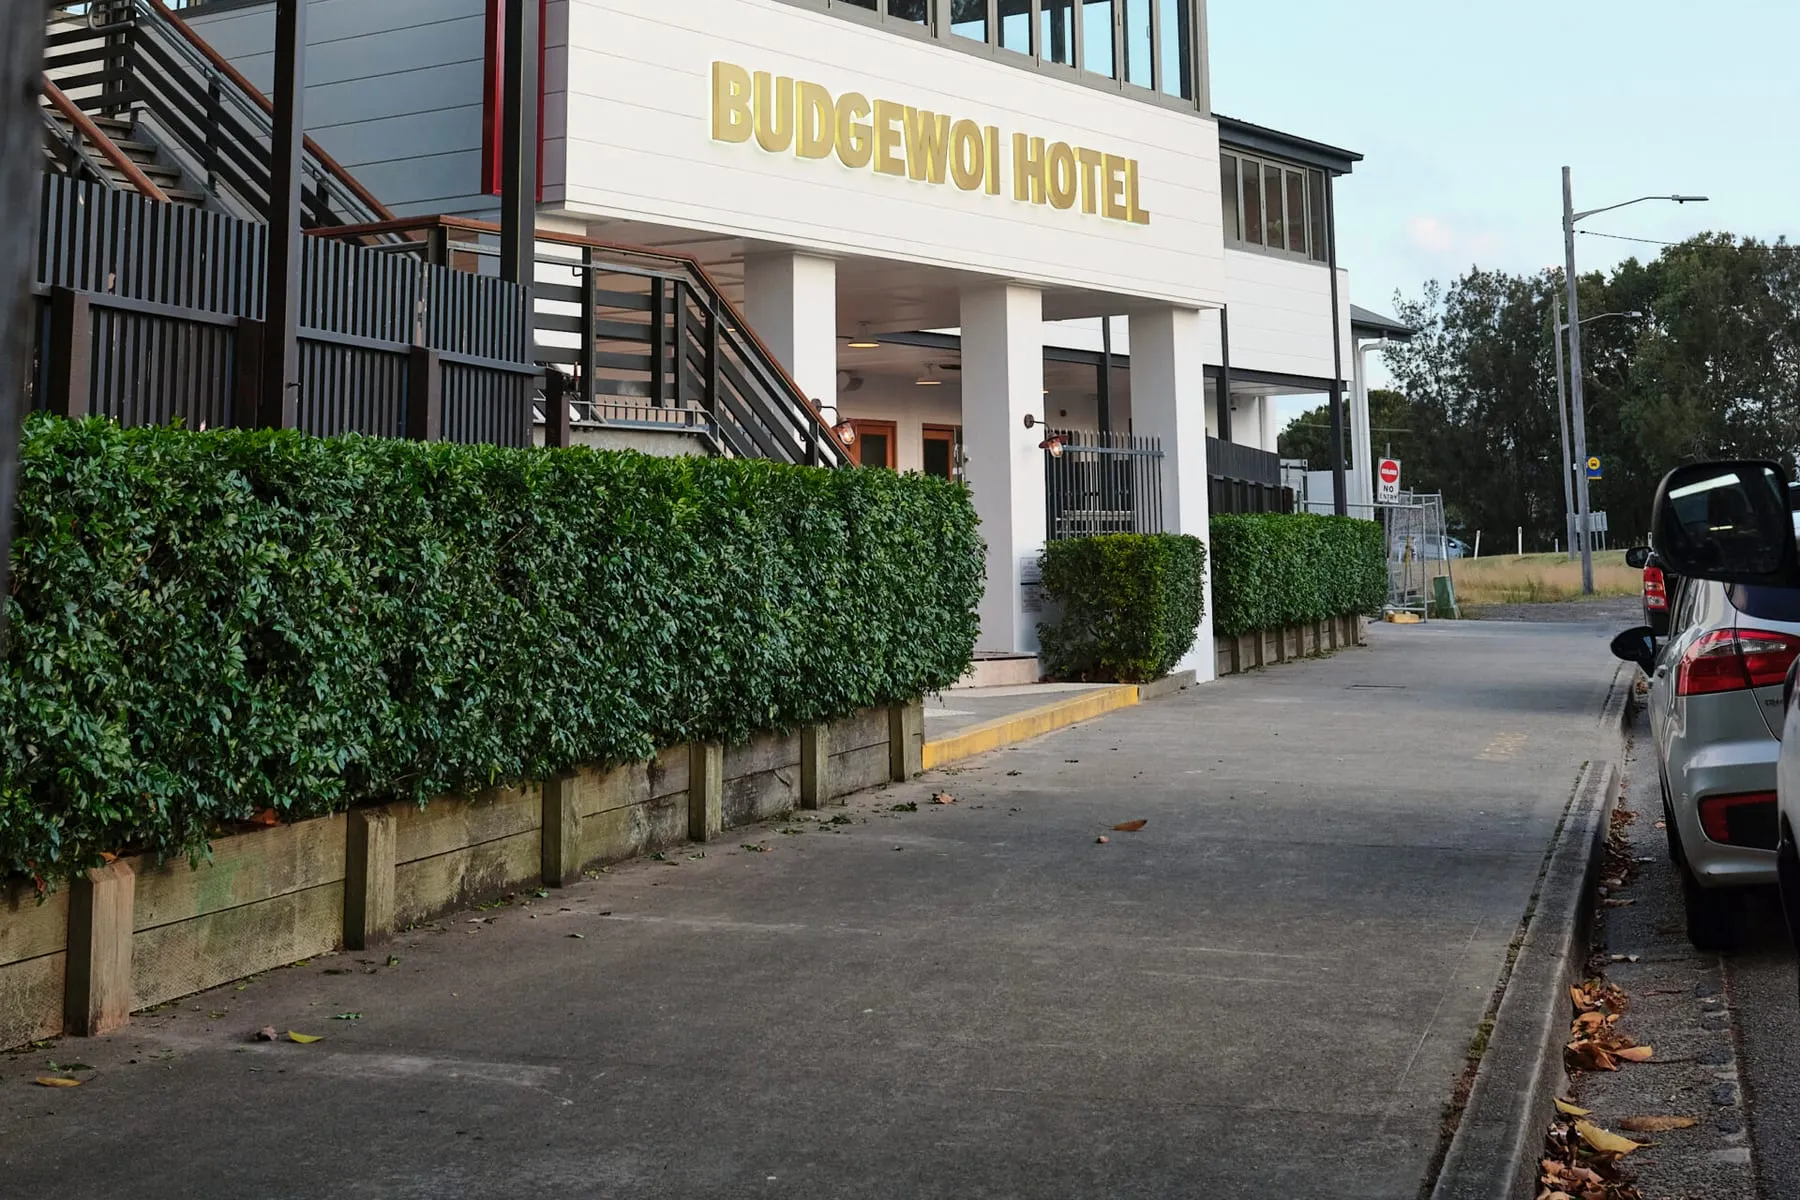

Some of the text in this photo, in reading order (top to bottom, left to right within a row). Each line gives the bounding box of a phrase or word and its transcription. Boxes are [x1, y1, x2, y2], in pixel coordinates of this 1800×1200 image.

[712, 61, 1150, 225] BUDGEWOI HOTEL
[1383, 485, 1394, 493] NO
